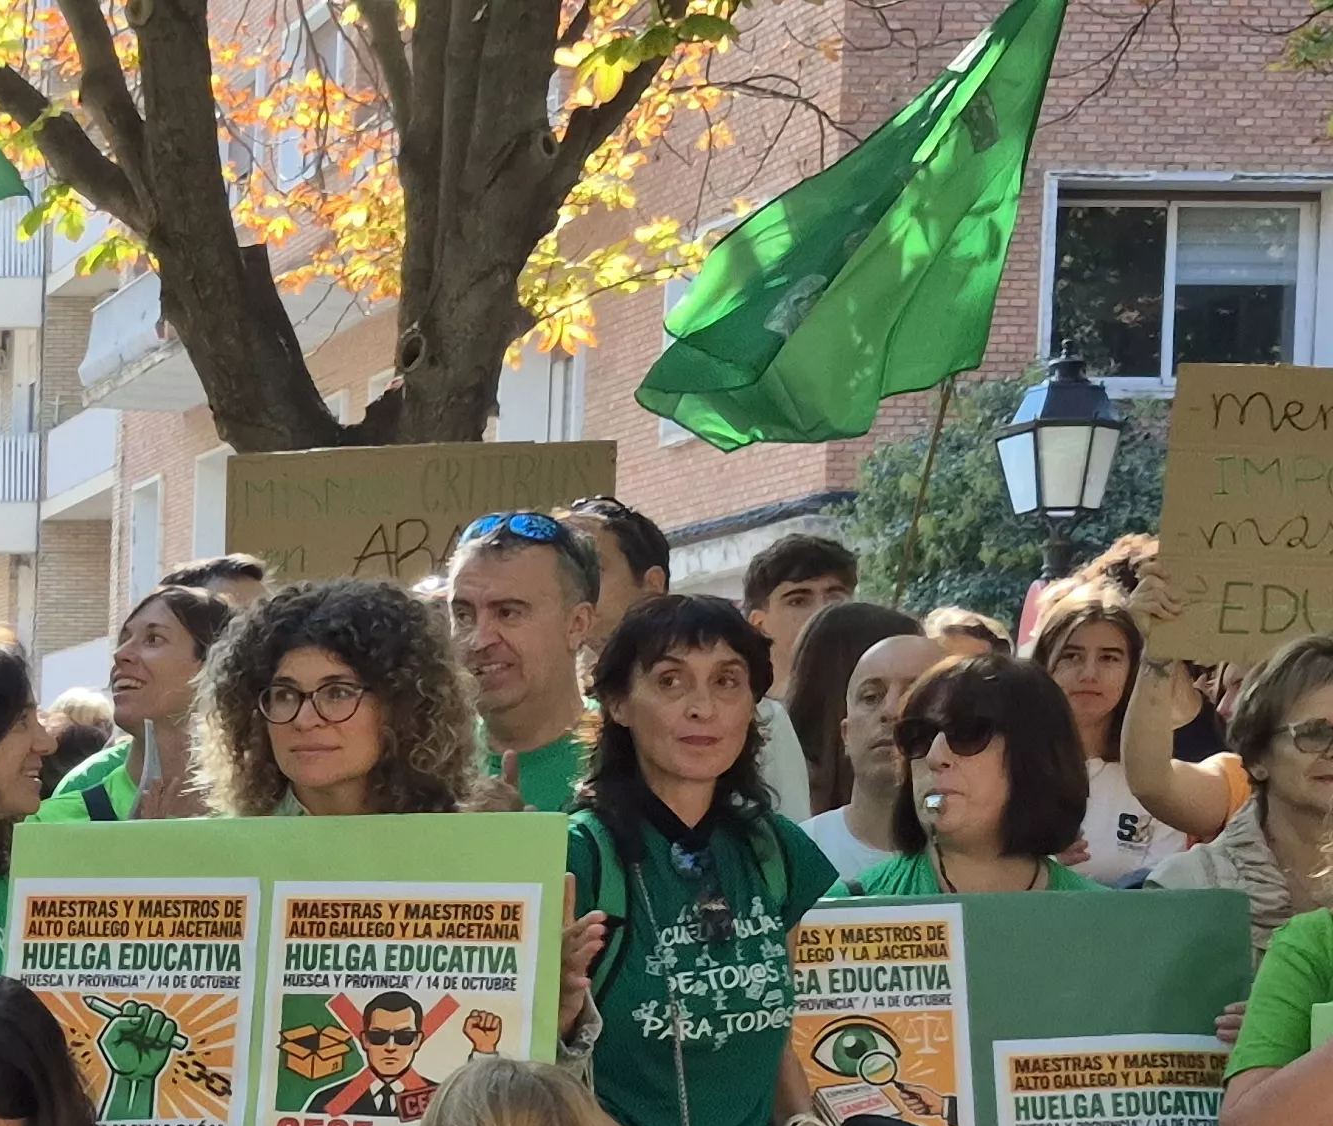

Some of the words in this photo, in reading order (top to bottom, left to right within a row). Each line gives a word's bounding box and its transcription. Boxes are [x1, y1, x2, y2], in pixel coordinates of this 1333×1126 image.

[32, 899, 118, 918] MAESTRAS
[123, 900, 134, 918] Y
[138, 899, 219, 918] MAESTROS
[224, 901, 243, 918] DE
[292, 902, 382, 919] MAESTRAS
[389, 903, 399, 919] Y
[404, 903, 494, 921] MAESTROS
[500, 904, 521, 921] DE
[27, 919, 64, 937] ALTO
[67, 919, 129, 938] GALLEGO
[135, 920, 145, 938] Y
[148, 920, 165, 937] LA
[168, 920, 242, 938] JACETANIA
[289, 921, 326, 937] ALTO
[329, 921, 394, 938] GALLEGO
[399, 921, 409, 937] Y
[413, 922, 432, 938] LA
[436, 923, 520, 940] JACETANIA
[823, 929, 835, 945] Y
[841, 926, 921, 944] MAESTROS
[927, 925, 945, 941] DE
[21, 942, 111, 971] HUELGA
[118, 942, 242, 972] EDUCATIVA
[285, 943, 377, 972] HUELGA
[384, 944, 518, 974] EDUCATIVA
[852, 945, 869, 960] LA
[874, 943, 949, 960] JACETANIA
[21, 973, 64, 988] HUESCA
[157, 974, 169, 988] 14
[172, 975, 188, 988] DE
[190, 975, 241, 989] OCTUBRE
[283, 974, 330, 988] HUESCA
[426, 976, 440, 990] 14
[443, 976, 458, 990] DE
[461, 976, 518, 992] OCTUBRE
[828, 964, 952, 994] EDUCATIVA
[1015, 1054, 1102, 1074] MAESTRAS
[1109, 1054, 1120, 1071] Y
[1123, 1053, 1206, 1070] MAESTROS
[1015, 1074, 1050, 1091] ALTO
[1053, 1072, 1117, 1090] GALLEGO
[1135, 1071, 1154, 1086] LA
[1014, 1093, 1104, 1121] HUELGA
